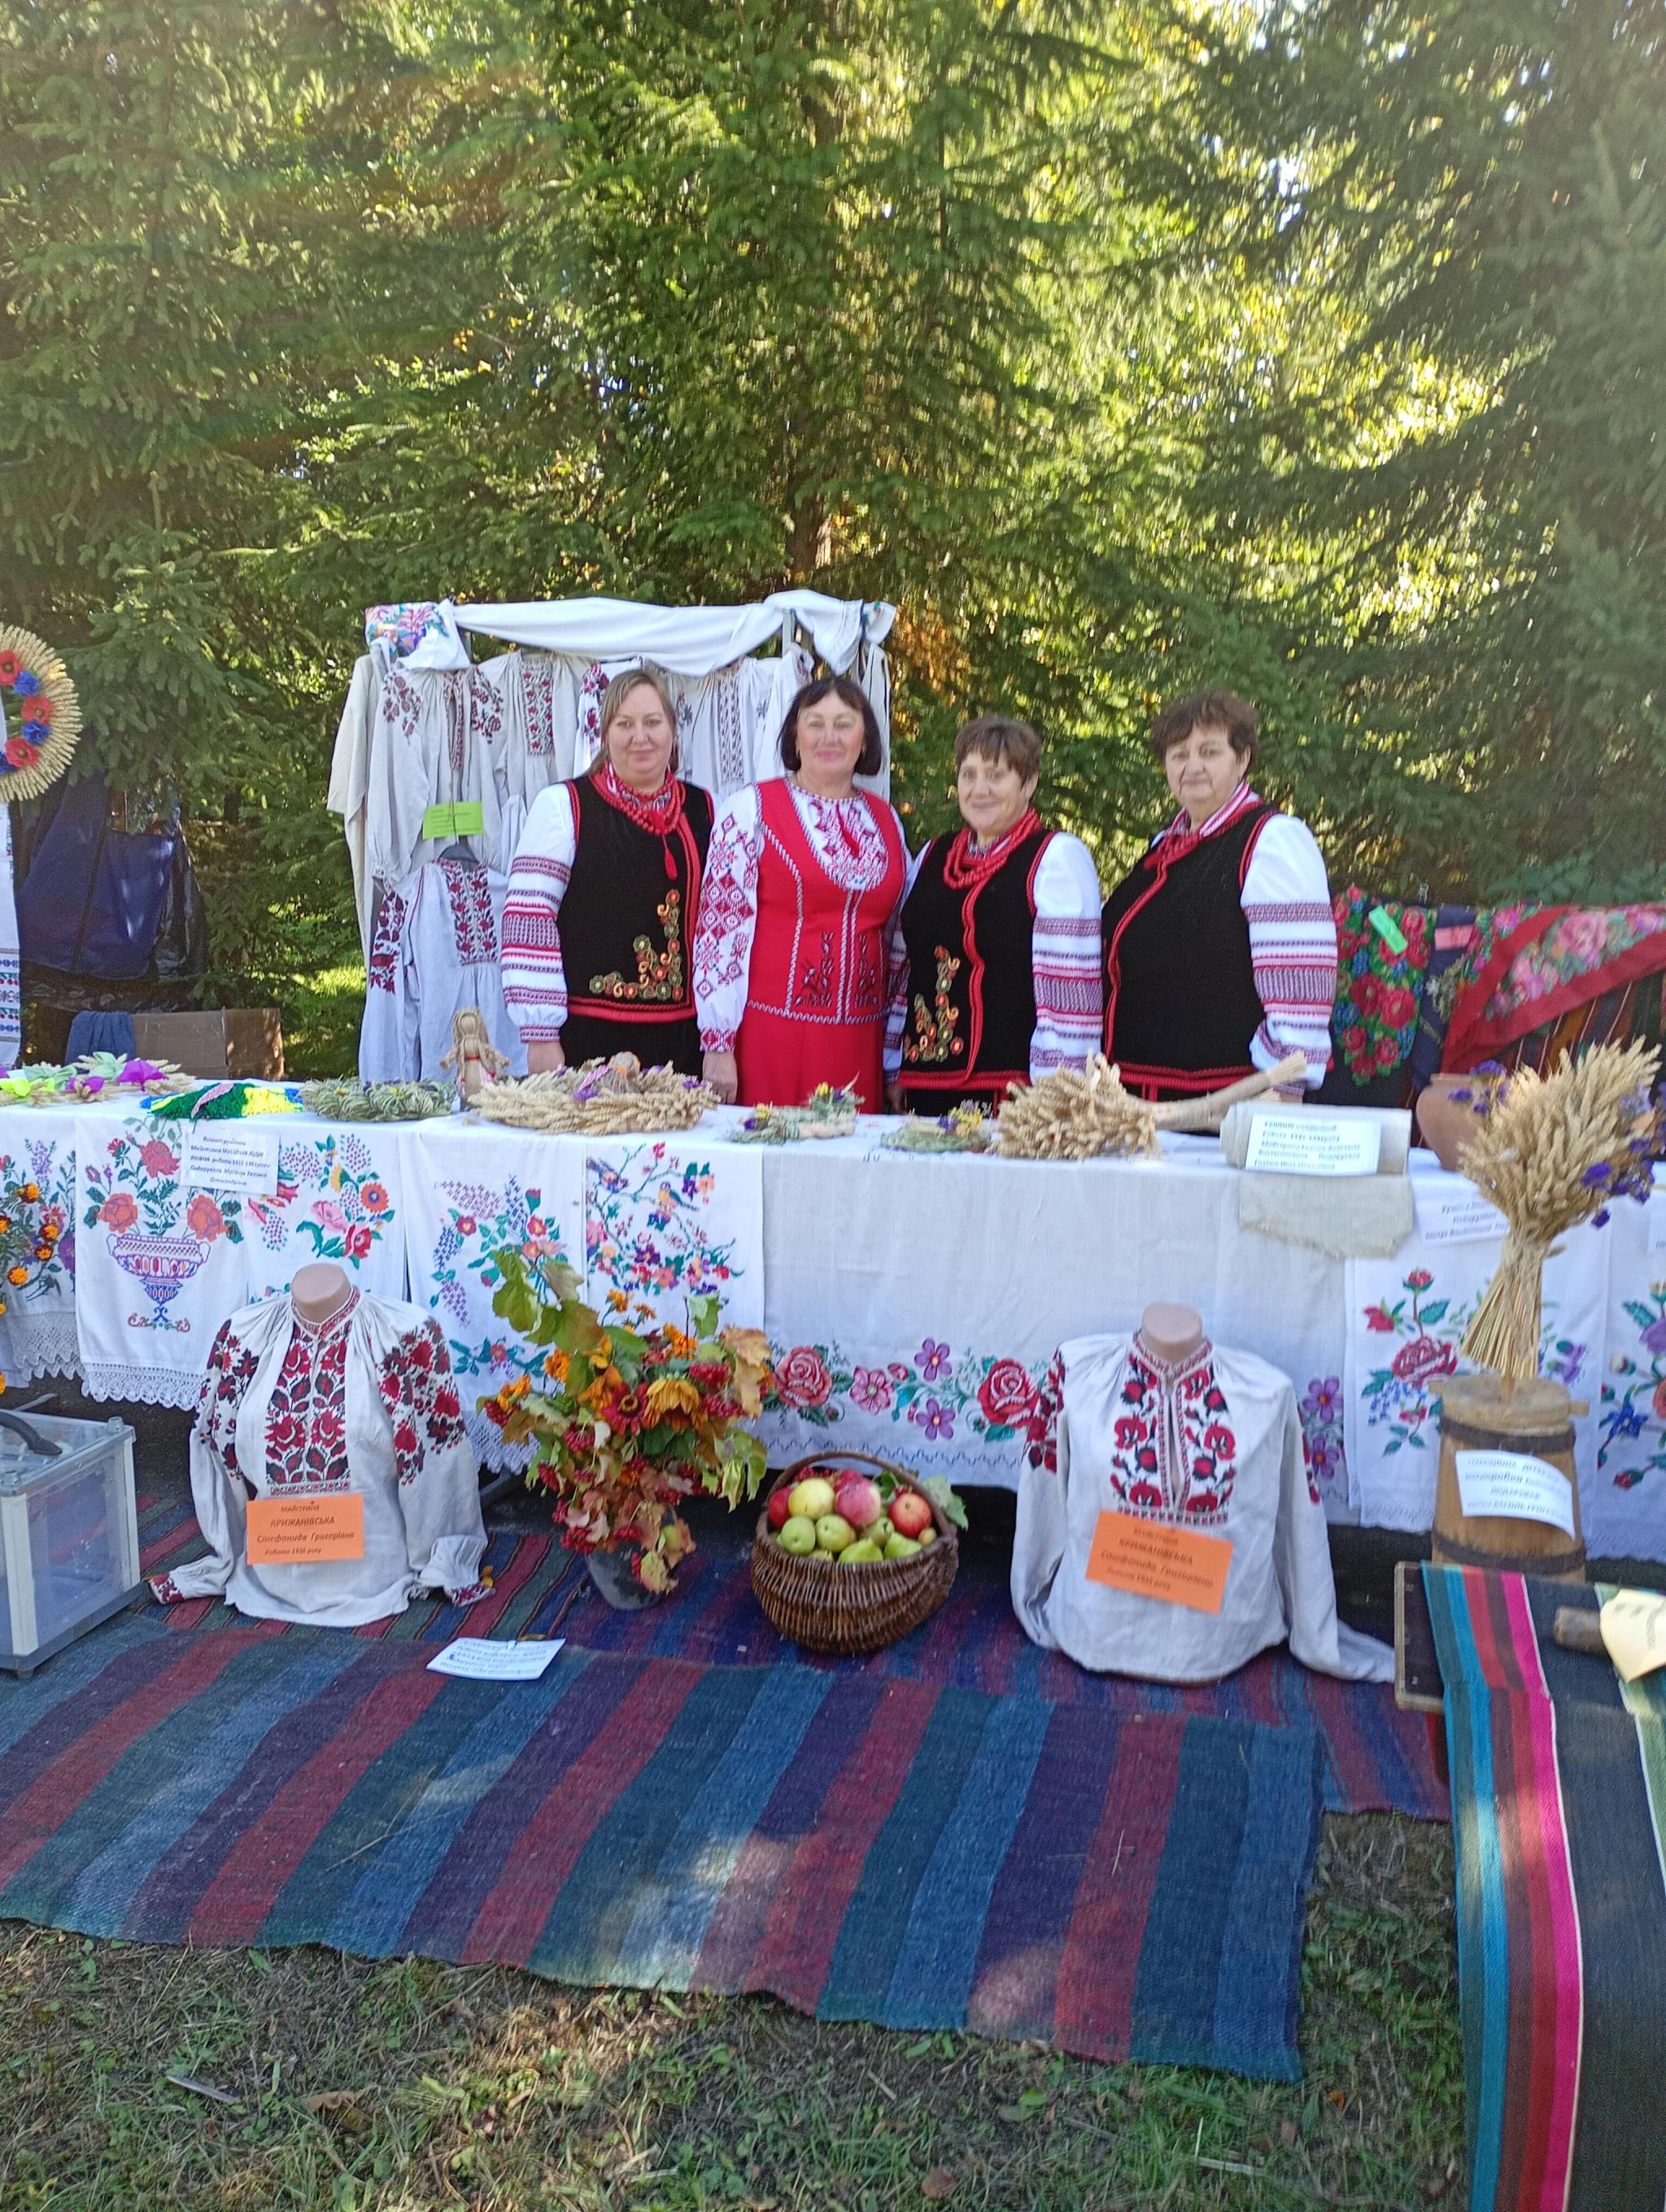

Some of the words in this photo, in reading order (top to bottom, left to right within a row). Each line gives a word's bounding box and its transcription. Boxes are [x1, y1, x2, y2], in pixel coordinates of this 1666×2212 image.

[269, 1516, 335, 1528] КРИЖАНІВСЬКА
[256, 1534, 307, 1544] Стефанида
[310, 1531, 355, 1543] Григорівна
